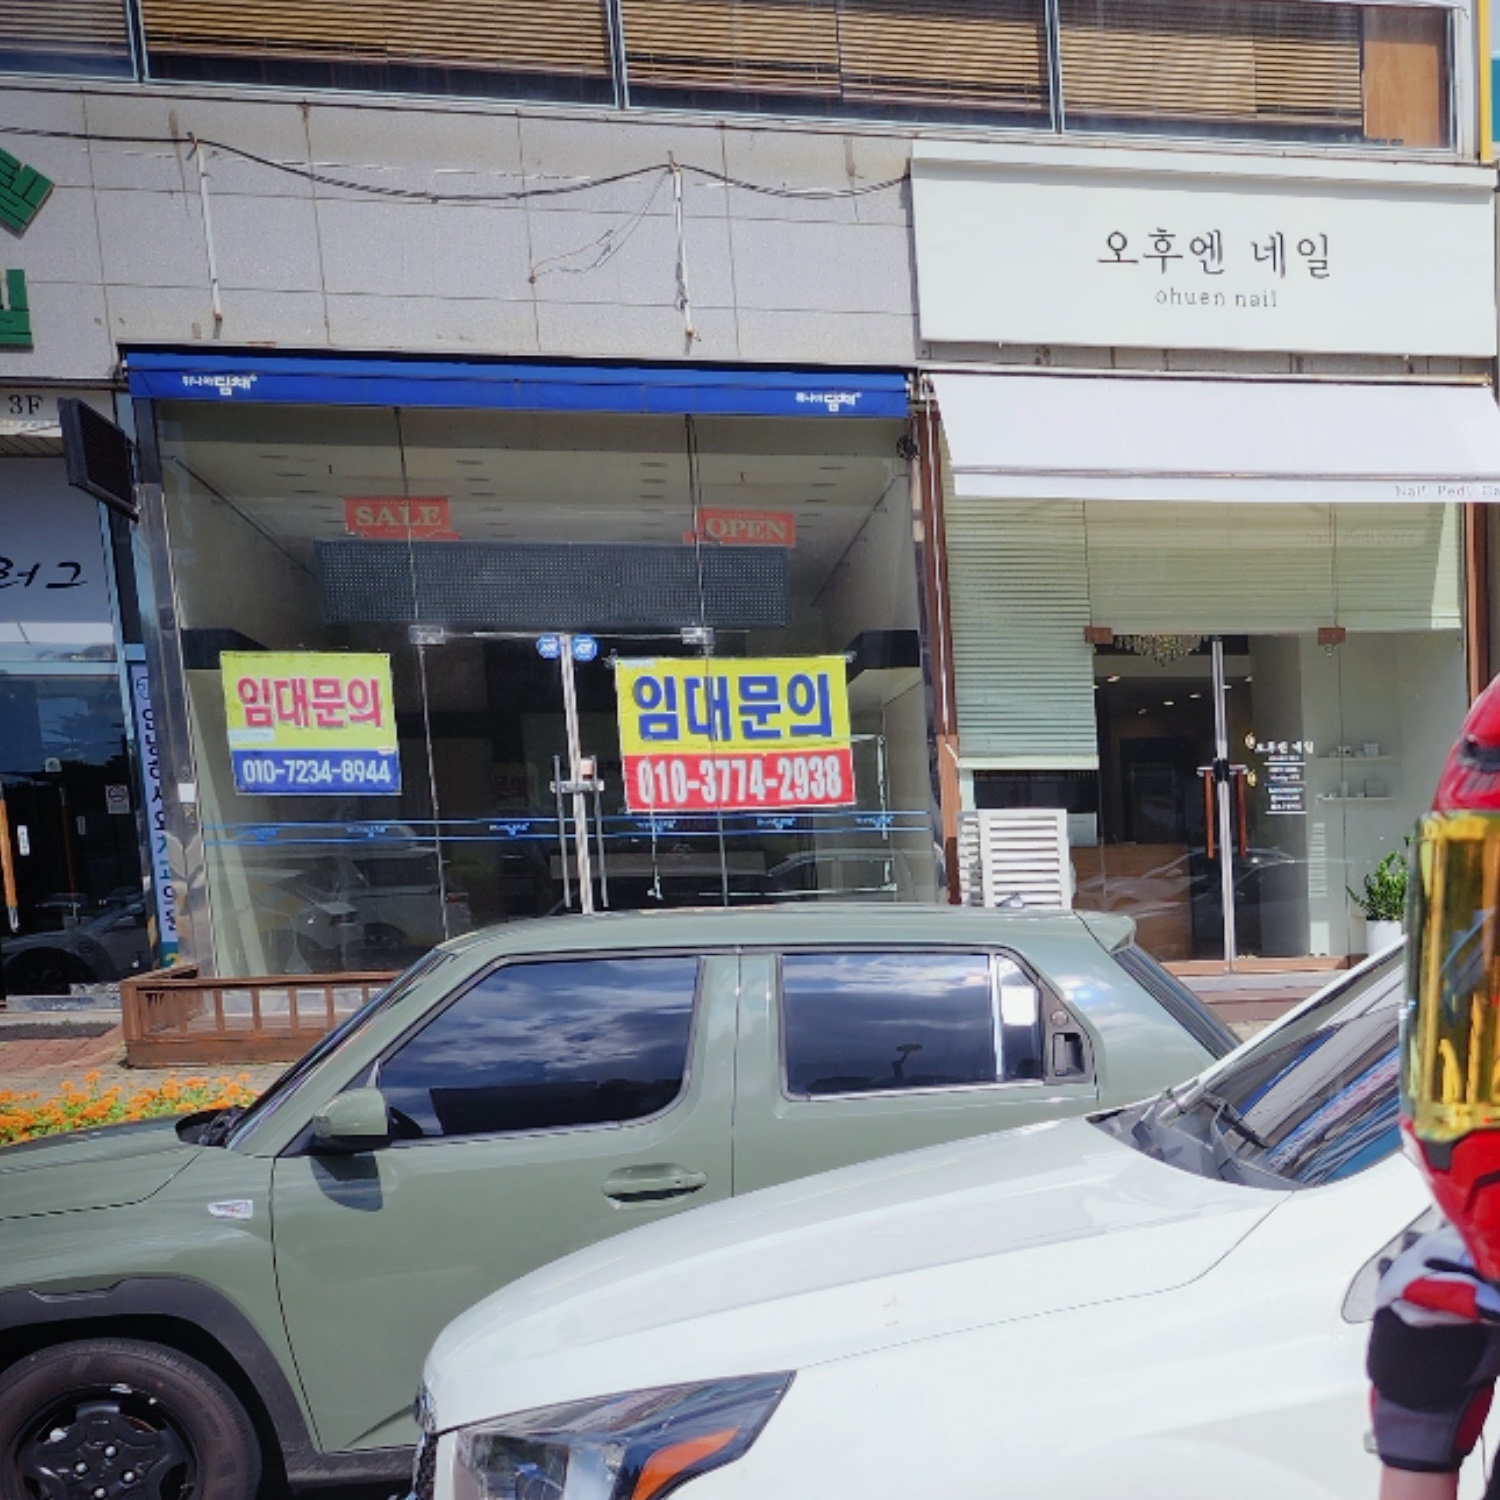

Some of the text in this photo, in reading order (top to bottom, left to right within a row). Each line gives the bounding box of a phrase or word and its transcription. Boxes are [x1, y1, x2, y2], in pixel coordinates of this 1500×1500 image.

[1096, 227, 1330, 279] 오후엔 네일
[1155, 286, 1278, 308] ohuen nail
[354, 504, 441, 527] SALE
[704, 516, 788, 541] OPEN
[236, 676, 384, 729] 임대문의
[632, 672, 833, 742] 임대문의
[242, 759, 391, 784] 010-7234-8944
[636, 754, 843, 805] 010-3774-2938
